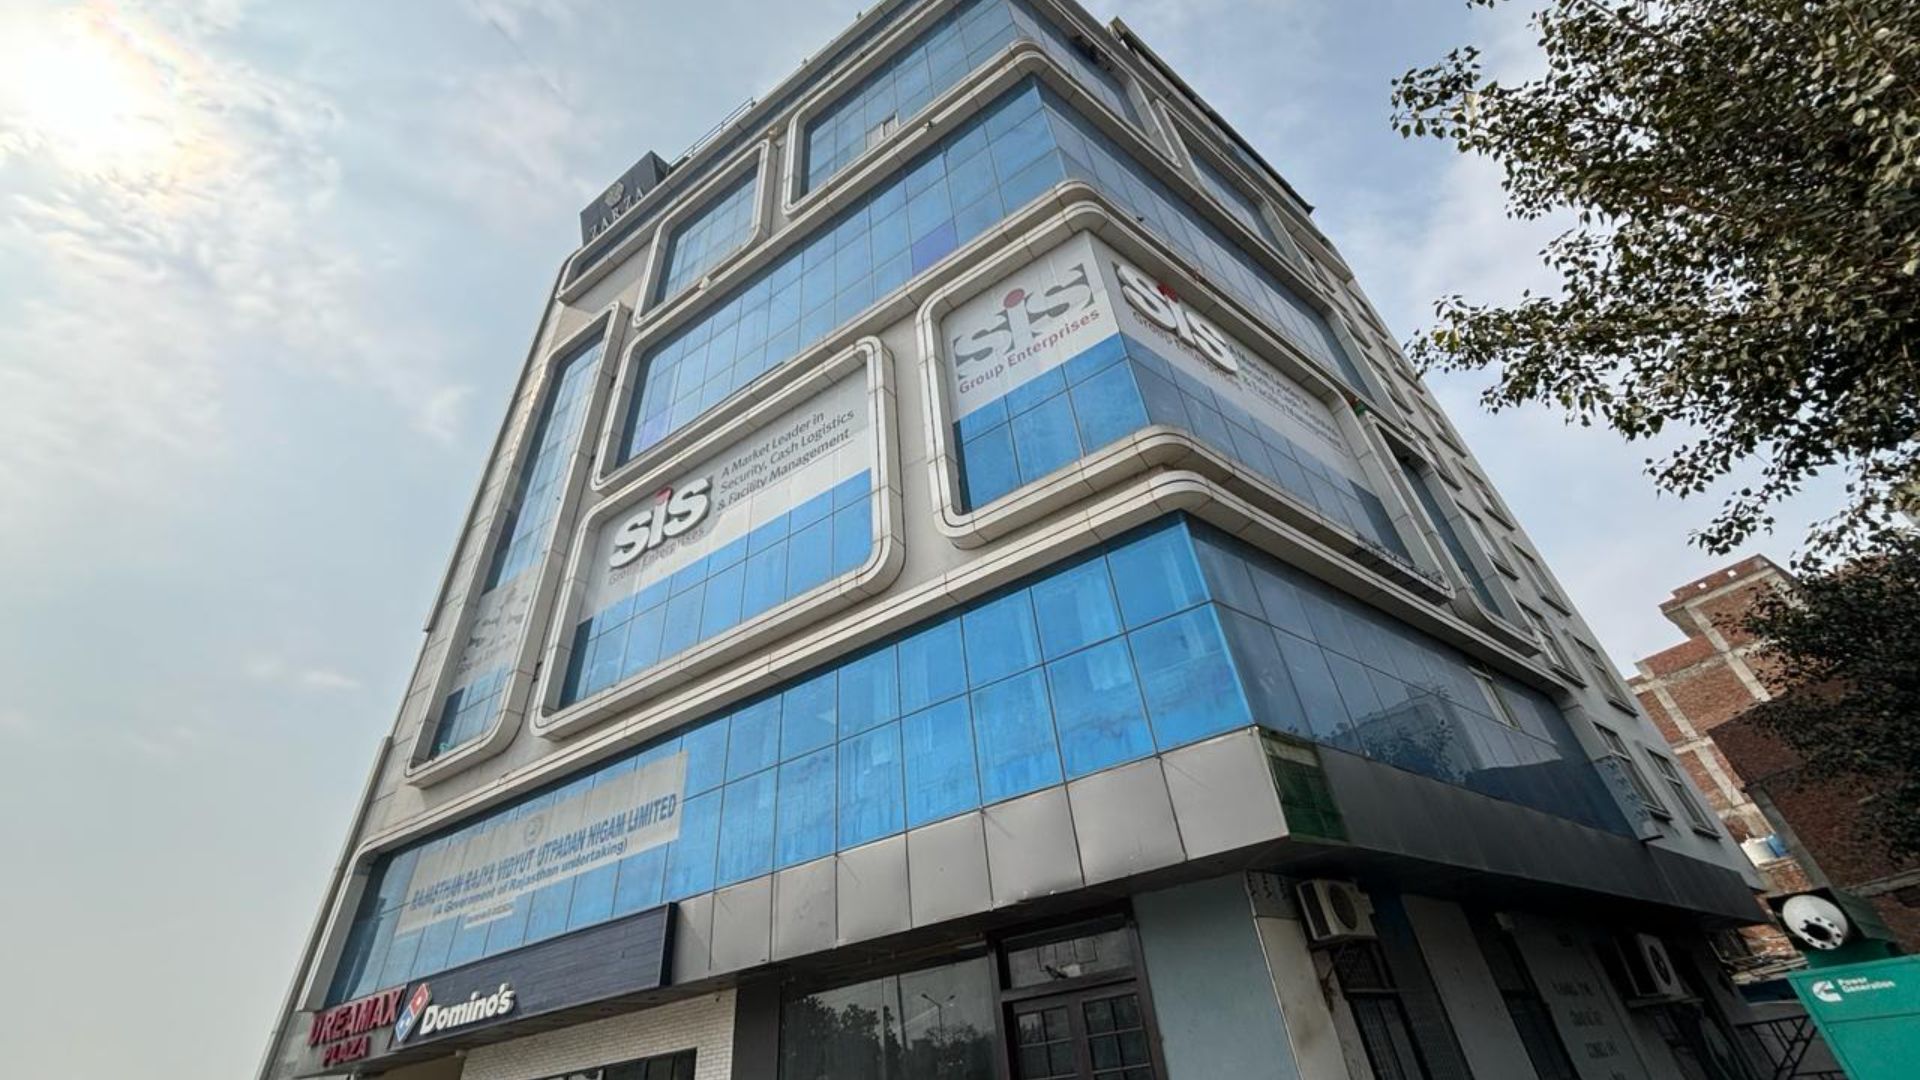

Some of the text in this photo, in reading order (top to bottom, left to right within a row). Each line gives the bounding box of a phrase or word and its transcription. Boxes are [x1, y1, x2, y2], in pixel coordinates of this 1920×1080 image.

[959, 309, 1100, 395] Group Enterprises
[721, 412, 825, 478] A Market Leader in
[770, 440, 799, 464] Cash
[801, 410, 855, 447] Logistics
[728, 475, 768, 505] Facility
[769, 428, 850, 482] Management
[587, 812, 627, 849] NIGAM
[627, 793, 678, 833] LIMITED
[561, 838, 629, 872] undertaking)
[307, 990, 405, 1047] DREAMAX
[419, 982, 515, 1035] Domino's
[323, 1034, 371, 1067] PLAZA
